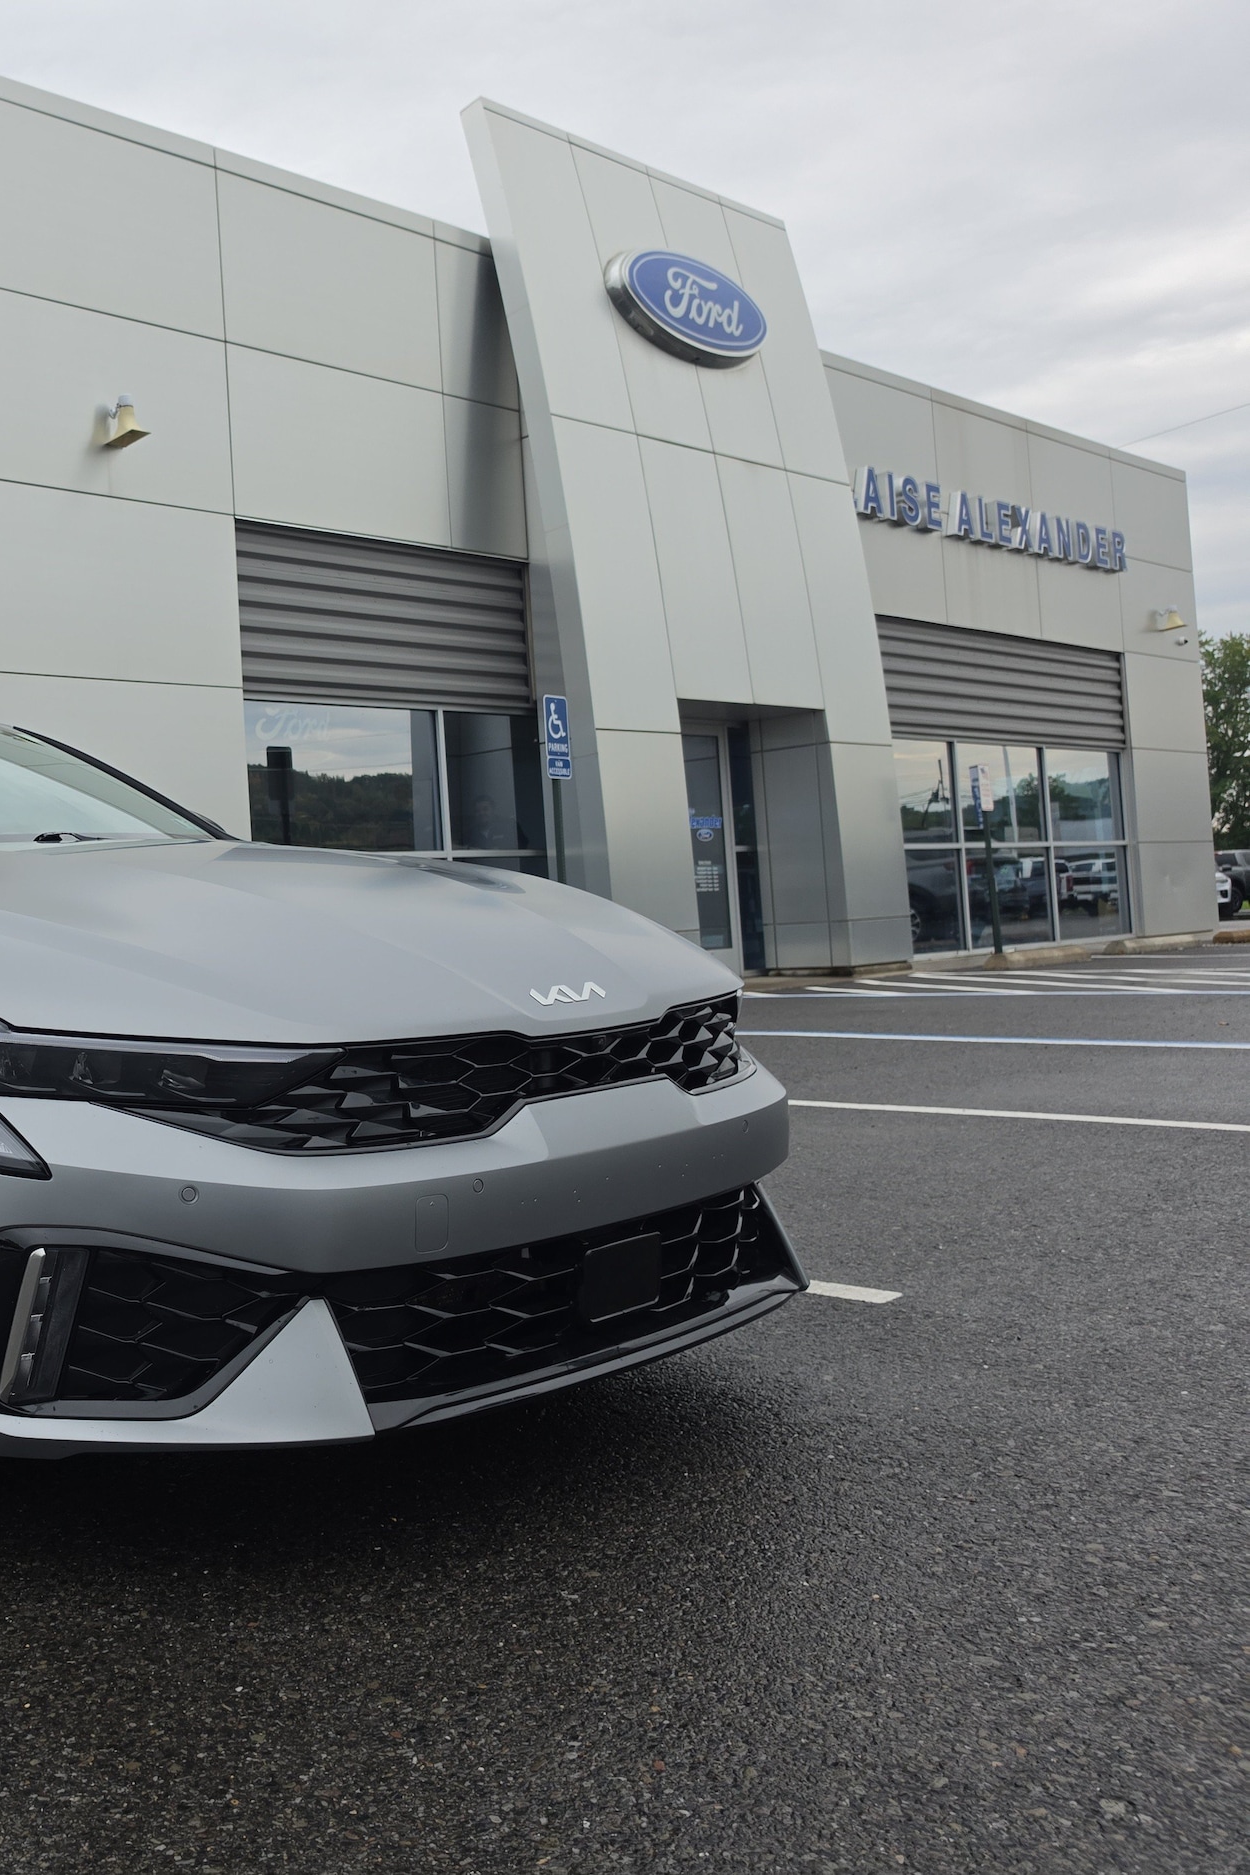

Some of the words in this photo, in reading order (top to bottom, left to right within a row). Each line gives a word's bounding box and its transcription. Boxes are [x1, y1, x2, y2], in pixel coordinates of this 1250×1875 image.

[664, 267, 743, 337] Ford
[854, 466, 943, 531] AISE
[954, 490, 1128, 572] ALEXANDER
[548, 742, 569, 754] PARKING
[529, 981, 607, 1006] KIA
